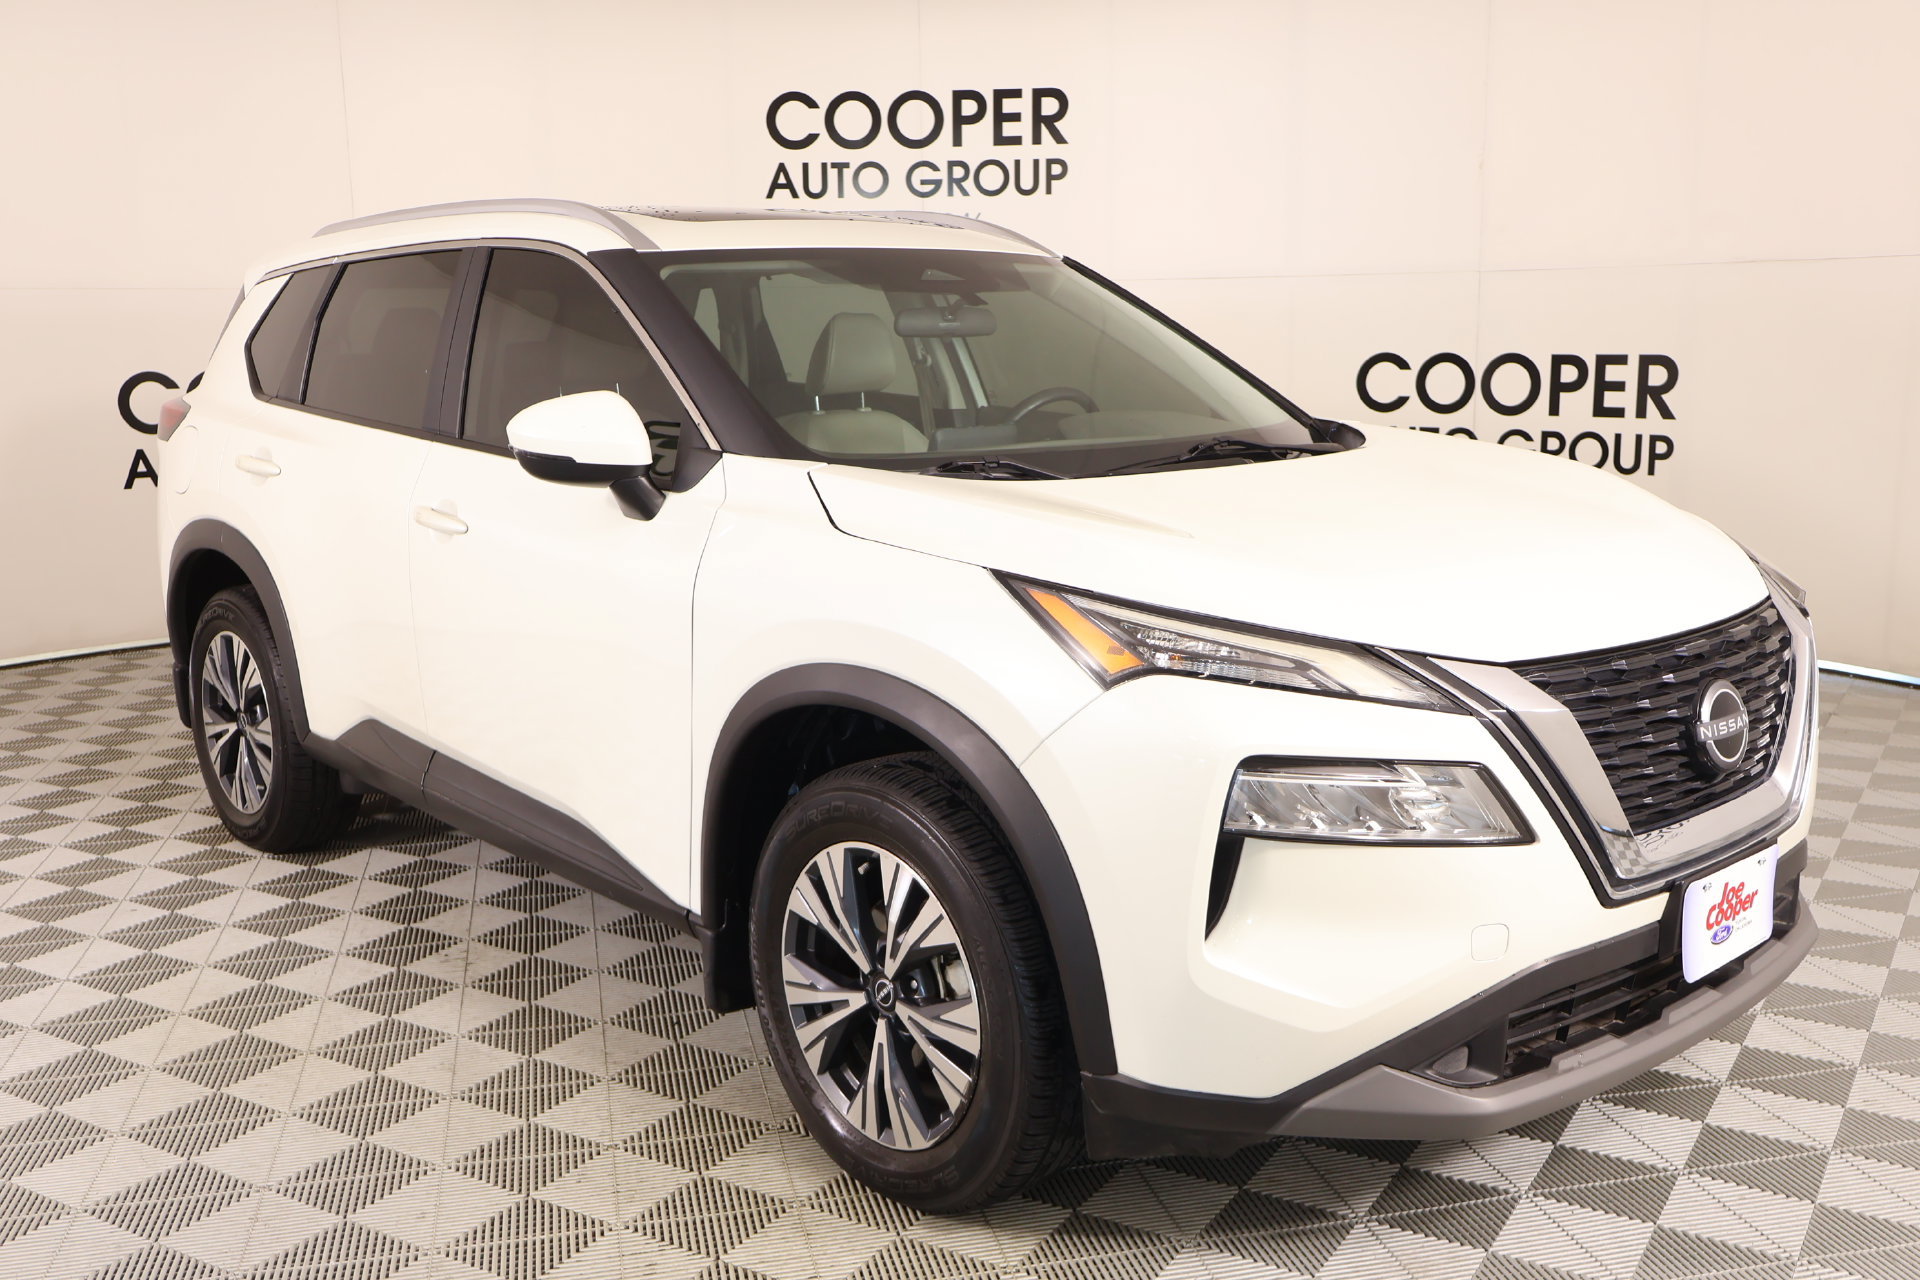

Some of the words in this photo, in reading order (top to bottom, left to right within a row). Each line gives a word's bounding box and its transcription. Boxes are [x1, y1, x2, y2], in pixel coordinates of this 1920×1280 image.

[766, 87, 1069, 150] COOPER
[766, 161, 889, 199] AUTO
[905, 158, 1069, 198] GROUP
[1356, 352, 1680, 420] COOPER
[1699, 713, 1748, 740] NISSAN
[1706, 889, 1758, 931] Cooper
[1717, 882, 1745, 909] Joe
